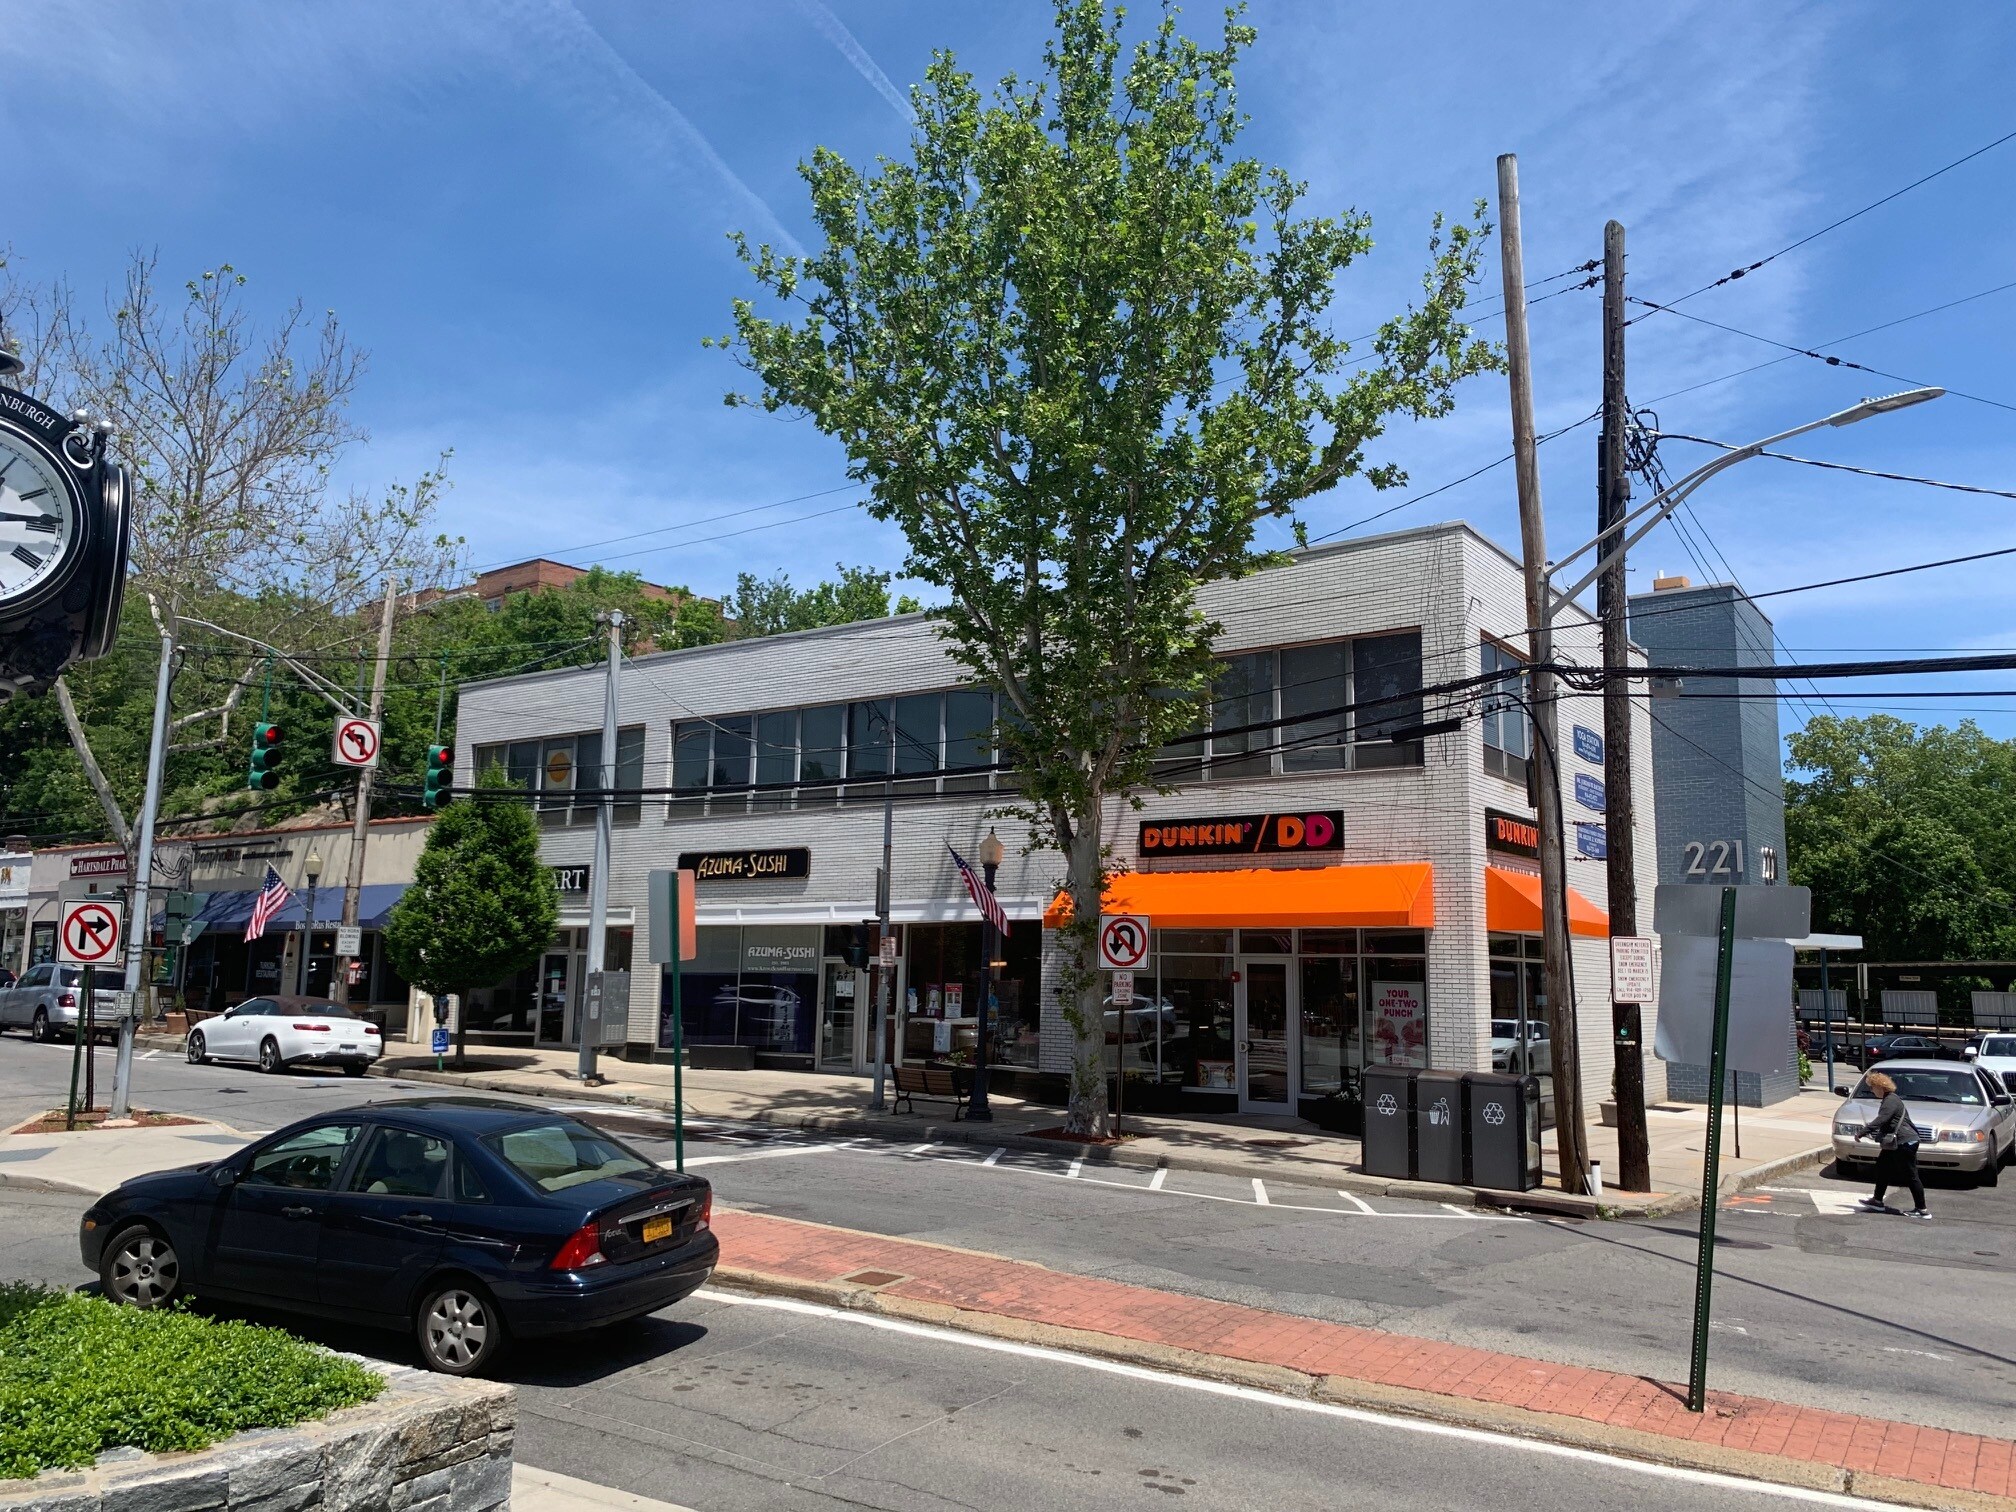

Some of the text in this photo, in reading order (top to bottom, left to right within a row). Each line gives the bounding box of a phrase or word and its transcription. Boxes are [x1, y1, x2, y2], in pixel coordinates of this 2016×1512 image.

[1684, 839, 1743, 874] 221
[78, 860, 110, 873] HARTSDALE
[696, 852, 788, 879] AZUMA-SUSHI
[748, 946, 815, 960] AZUMA-SUSHI
[1387, 989, 1409, 998] YOUR
[1379, 999, 1418, 1008] ONE-TWO
[1384, 1009, 1413, 1018] PUNCH
